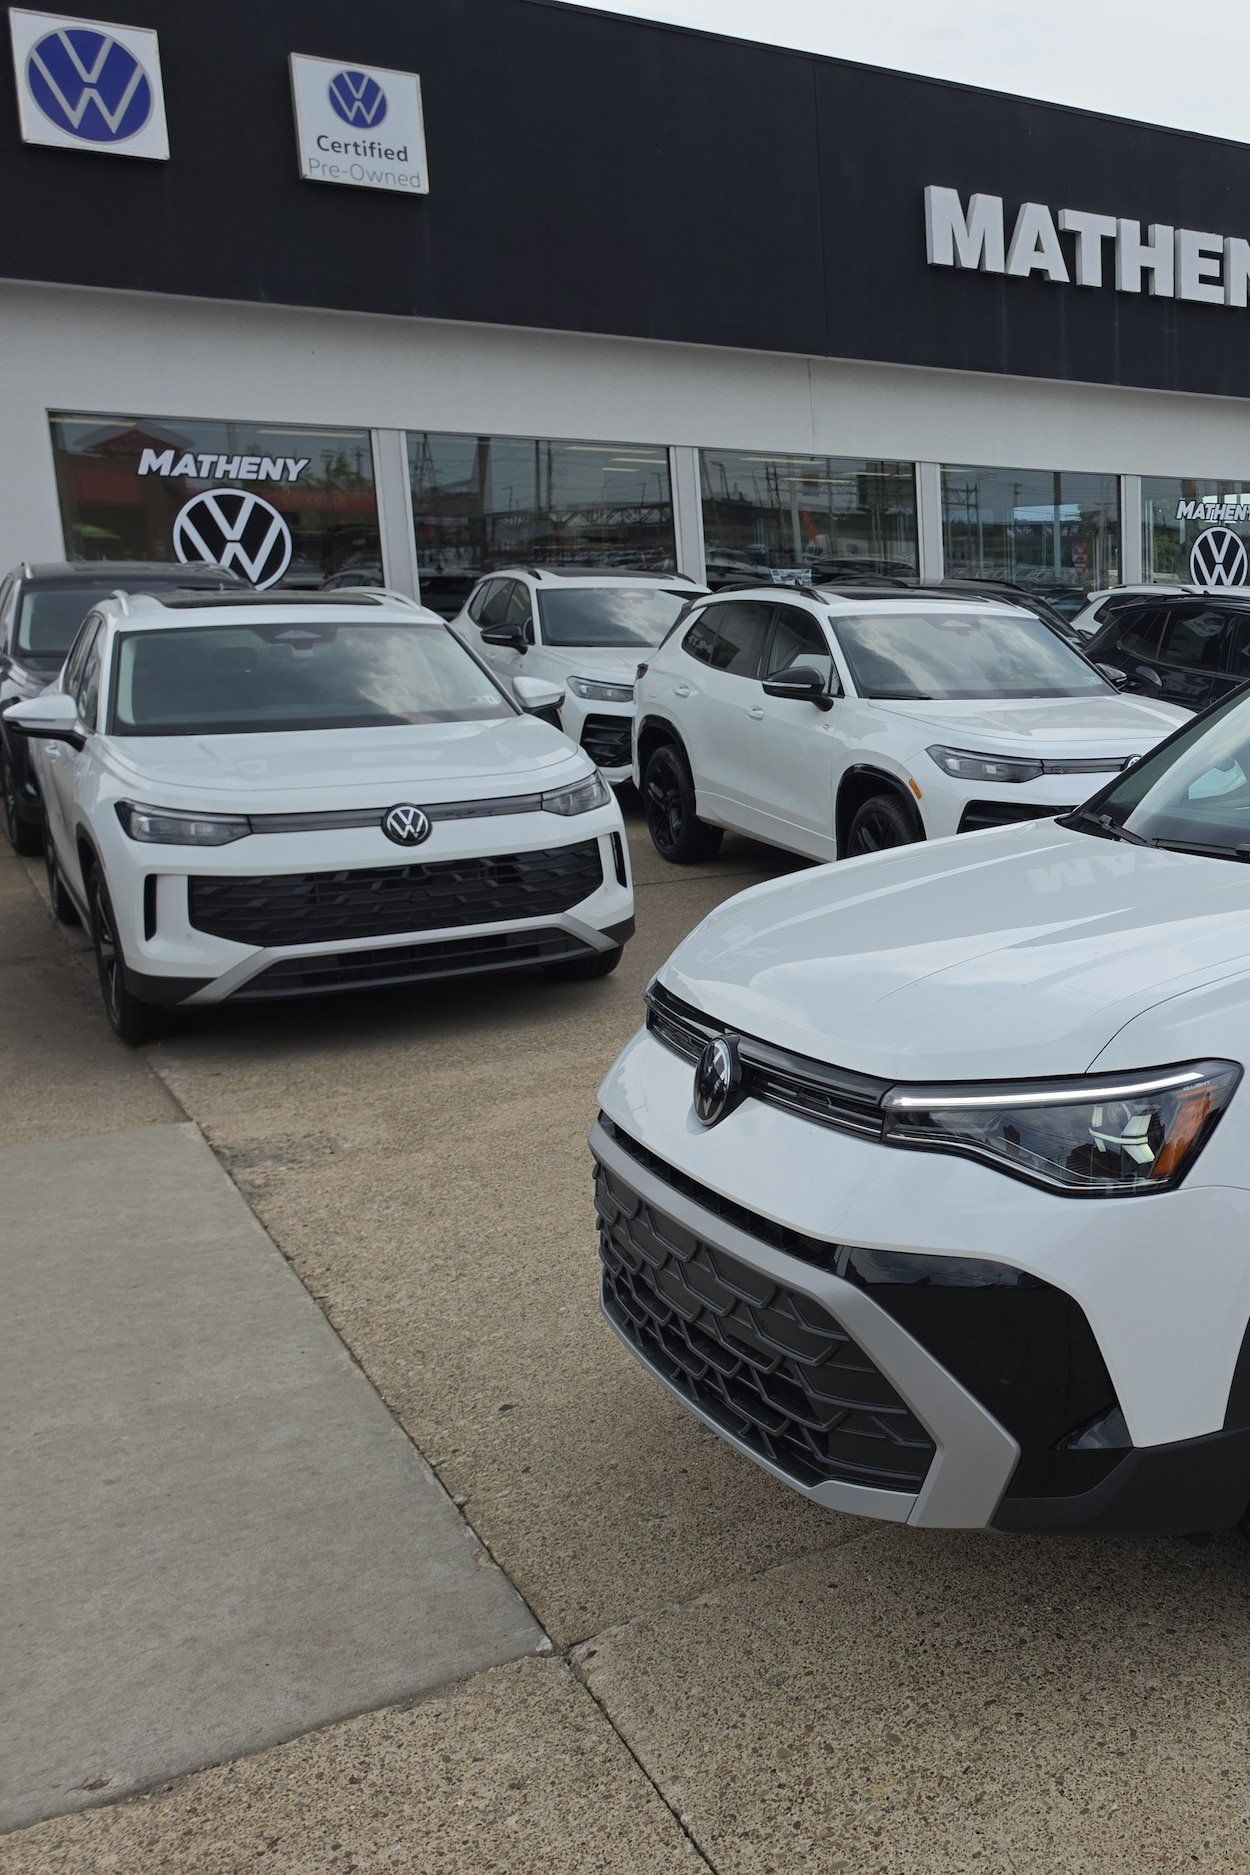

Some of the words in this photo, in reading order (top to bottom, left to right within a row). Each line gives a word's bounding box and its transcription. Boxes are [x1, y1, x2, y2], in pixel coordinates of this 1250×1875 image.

[317, 135, 408, 162] Certified
[308, 158, 421, 188] Pre-Owned
[138, 448, 309, 482] MATHENY
